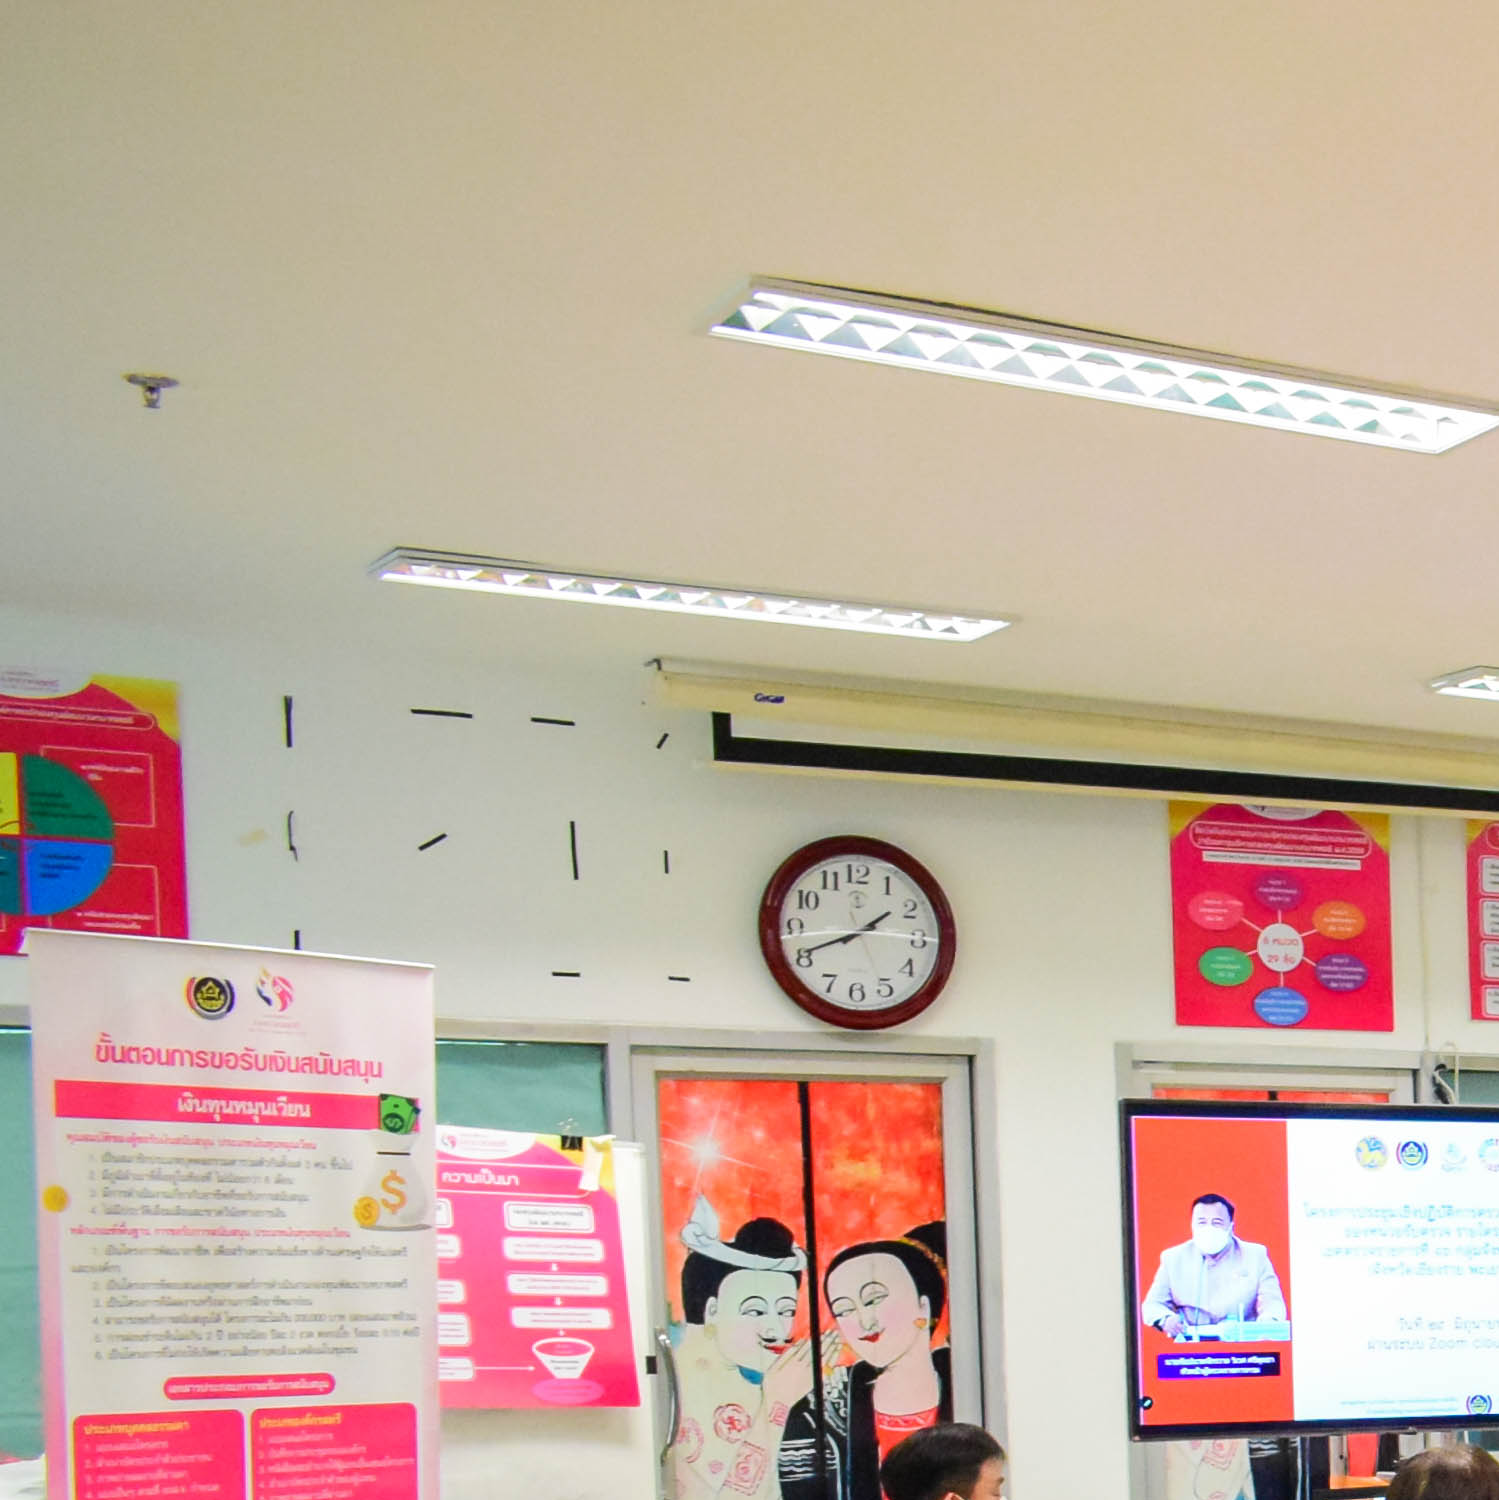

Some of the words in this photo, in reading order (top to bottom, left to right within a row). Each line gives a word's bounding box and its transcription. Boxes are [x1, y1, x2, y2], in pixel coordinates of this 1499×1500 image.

[820, 870, 840, 891] 11
[846, 864, 870, 885] 12
[883, 876, 891, 895] 1
[797, 889, 819, 910] 10
[903, 899, 917, 919] 2
[910, 929, 927, 949] 3
[796, 948, 813, 968] 8
[898, 958, 914, 977] 4
[822, 973, 838, 993] 7
[849, 982, 866, 1002] 6
[877, 978, 894, 998] 5
[95, 1032, 383, 1084] ขั้นตอนการขอรับเงินสนับสนุน
[177, 1091, 311, 1125] เงินทุนหมุนเวียน
[442, 1167, 520, 1186] ความเป็นมา
[1429, 1337, 1468, 1350] Zoom
